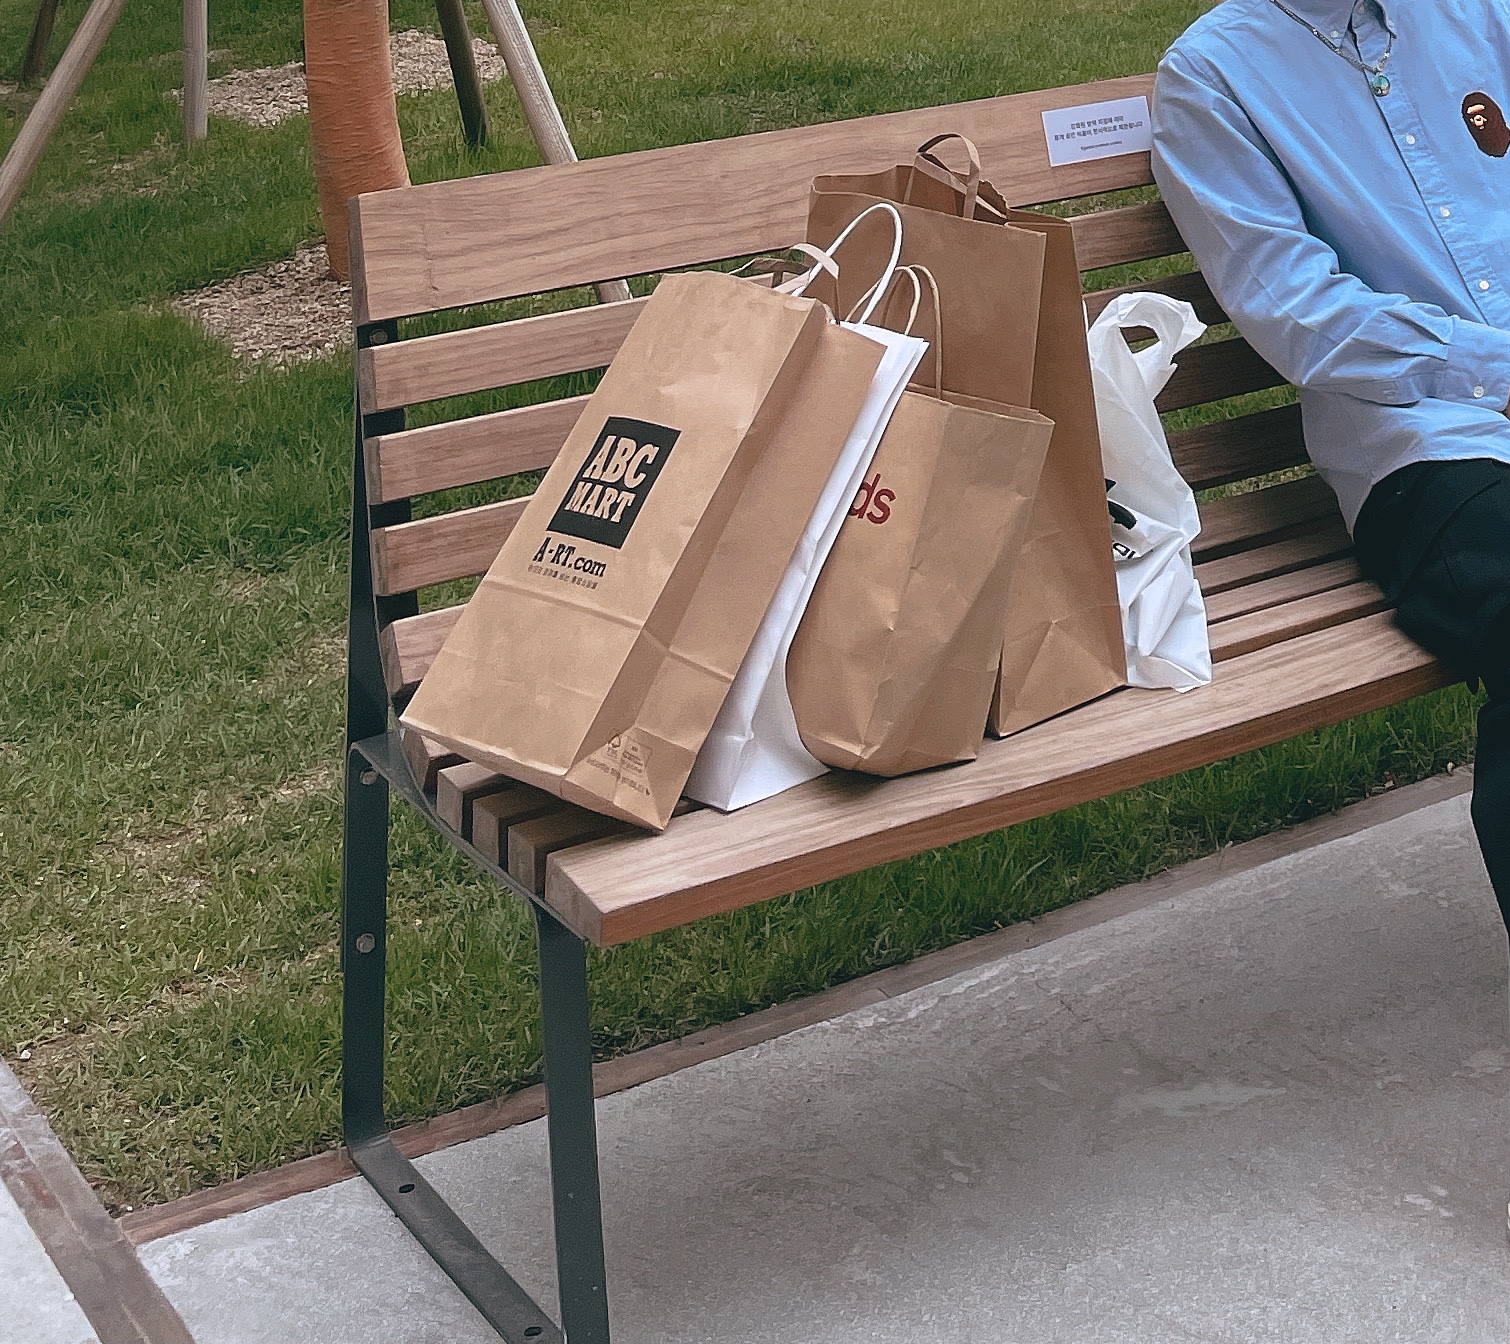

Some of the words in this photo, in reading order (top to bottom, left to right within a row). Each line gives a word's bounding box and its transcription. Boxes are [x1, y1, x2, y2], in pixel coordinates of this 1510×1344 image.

[582, 435, 660, 489] ABC
[564, 480, 637, 523] MART
[532, 537, 607, 577] A-RT.com
